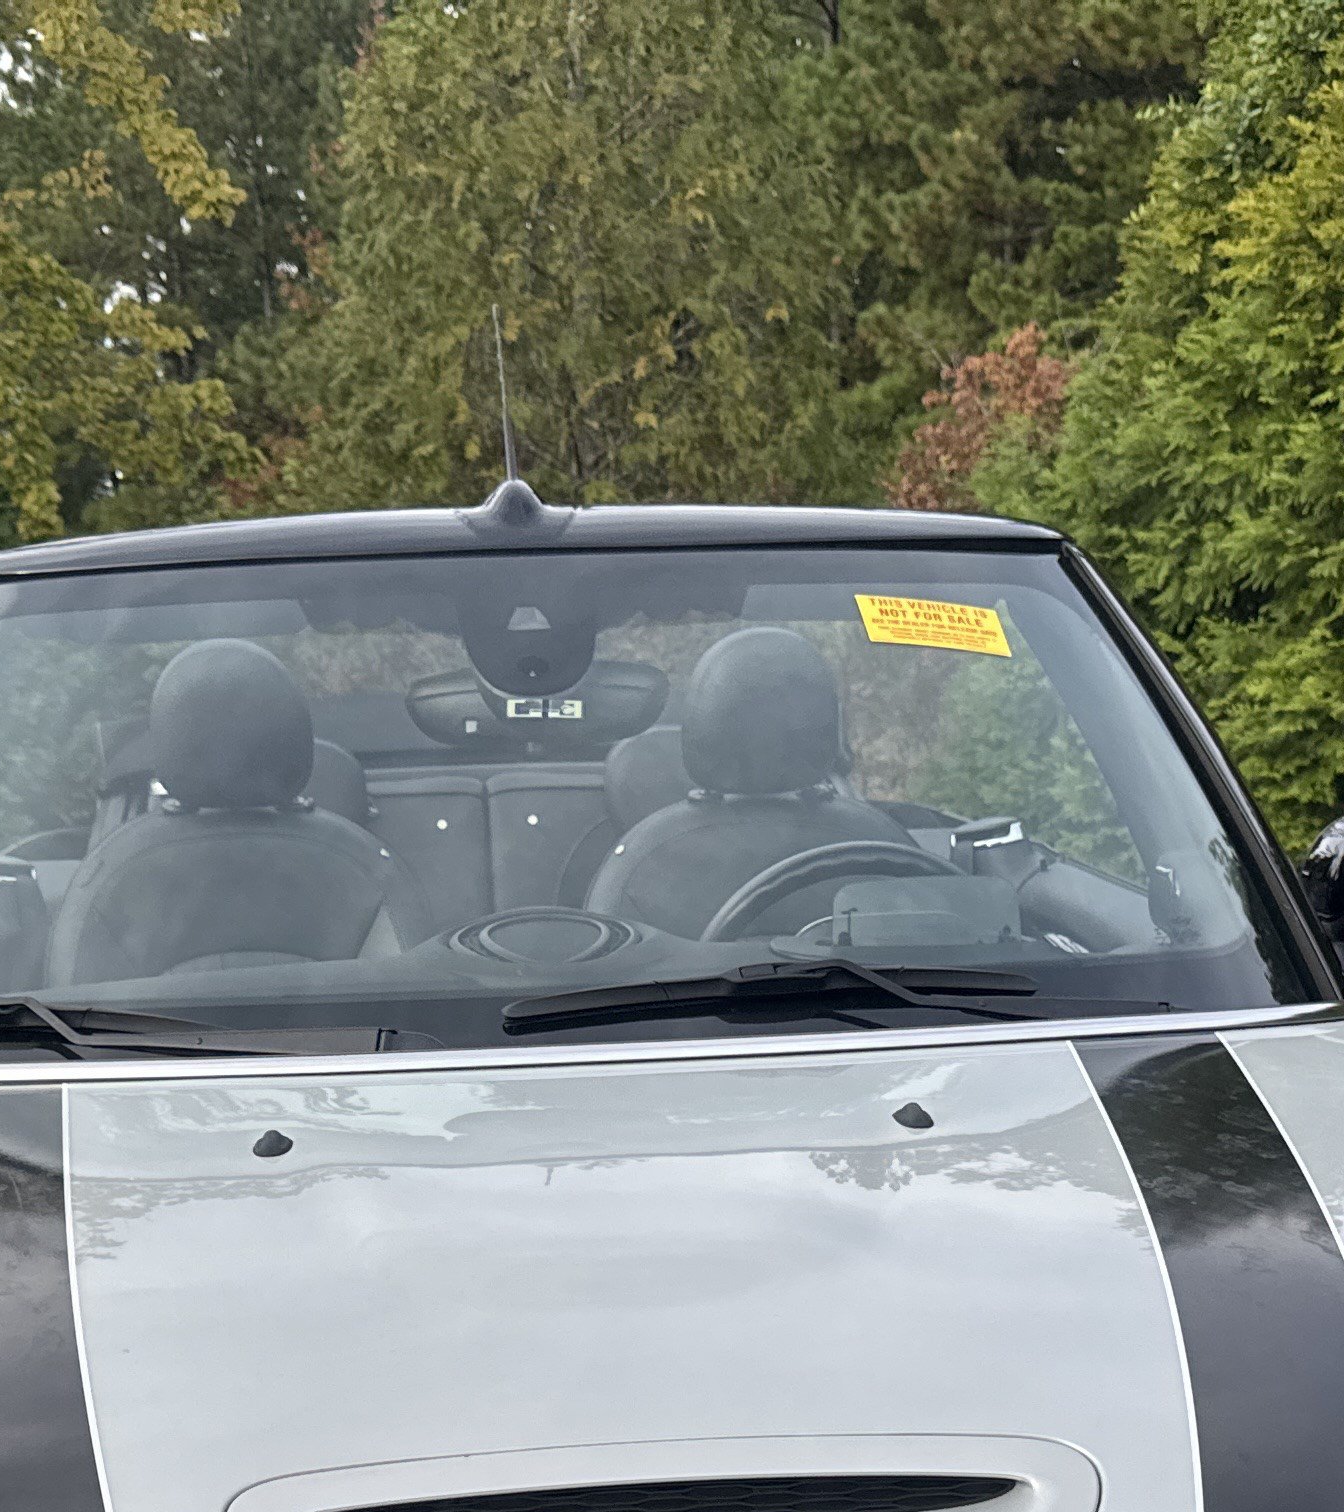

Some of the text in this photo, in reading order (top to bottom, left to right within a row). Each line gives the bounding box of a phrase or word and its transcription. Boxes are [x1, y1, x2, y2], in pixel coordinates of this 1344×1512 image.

[870, 598, 987, 619] THIS VEHICLE IS
[879, 609, 983, 627] NOT FOR SALE
